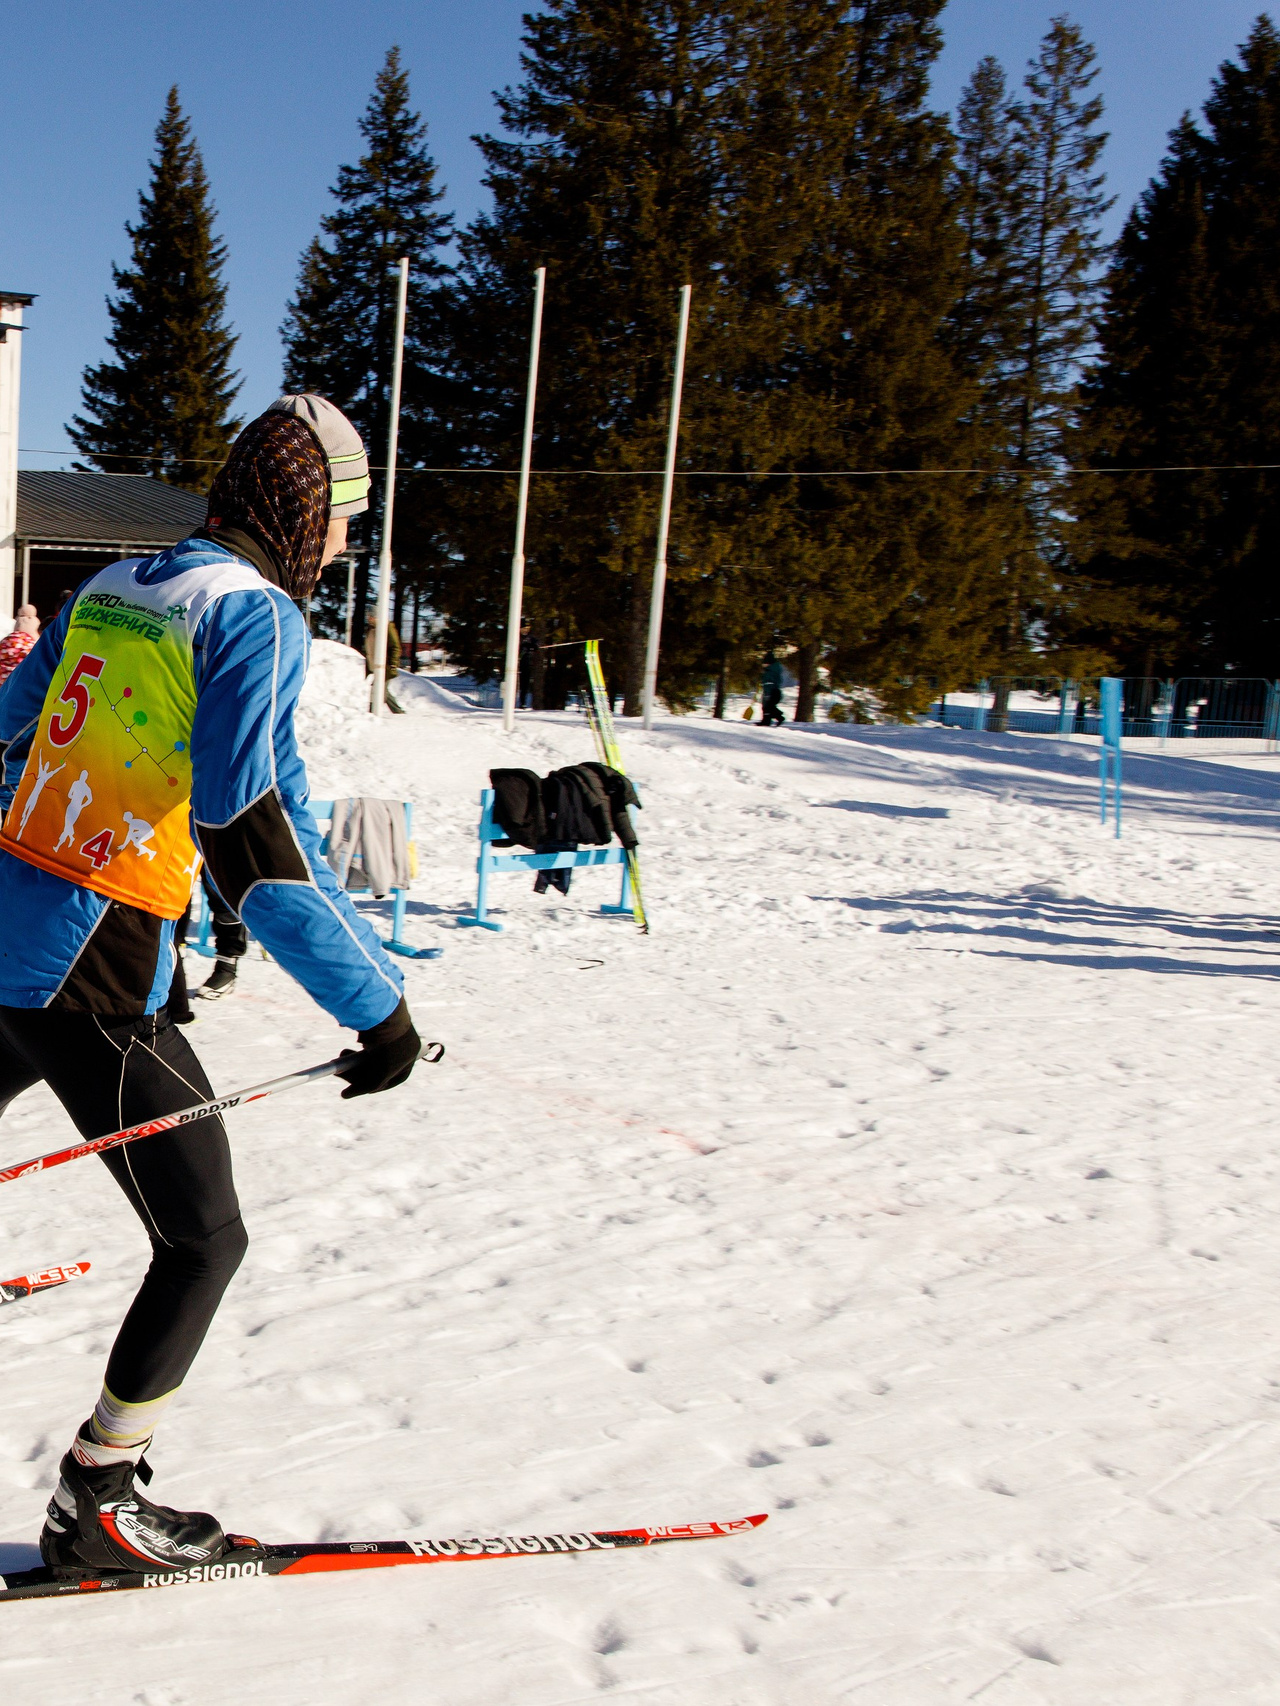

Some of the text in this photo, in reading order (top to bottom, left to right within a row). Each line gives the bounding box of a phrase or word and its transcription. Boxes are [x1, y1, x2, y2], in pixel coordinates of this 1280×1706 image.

[47, 652, 108, 749] 5
[79, 828, 116, 871] 4
[179, 1096, 241, 1124] Acadia
[26, 1268, 62, 1286] WCS
[119, 1514, 211, 1561] SPINE
[405, 1532, 616, 1557] ROSSIGNOL
[646, 1524, 714, 1538] WCS
[350, 1543, 378, 1553] S1
[143, 1560, 269, 1589] ROSSIGNOL
